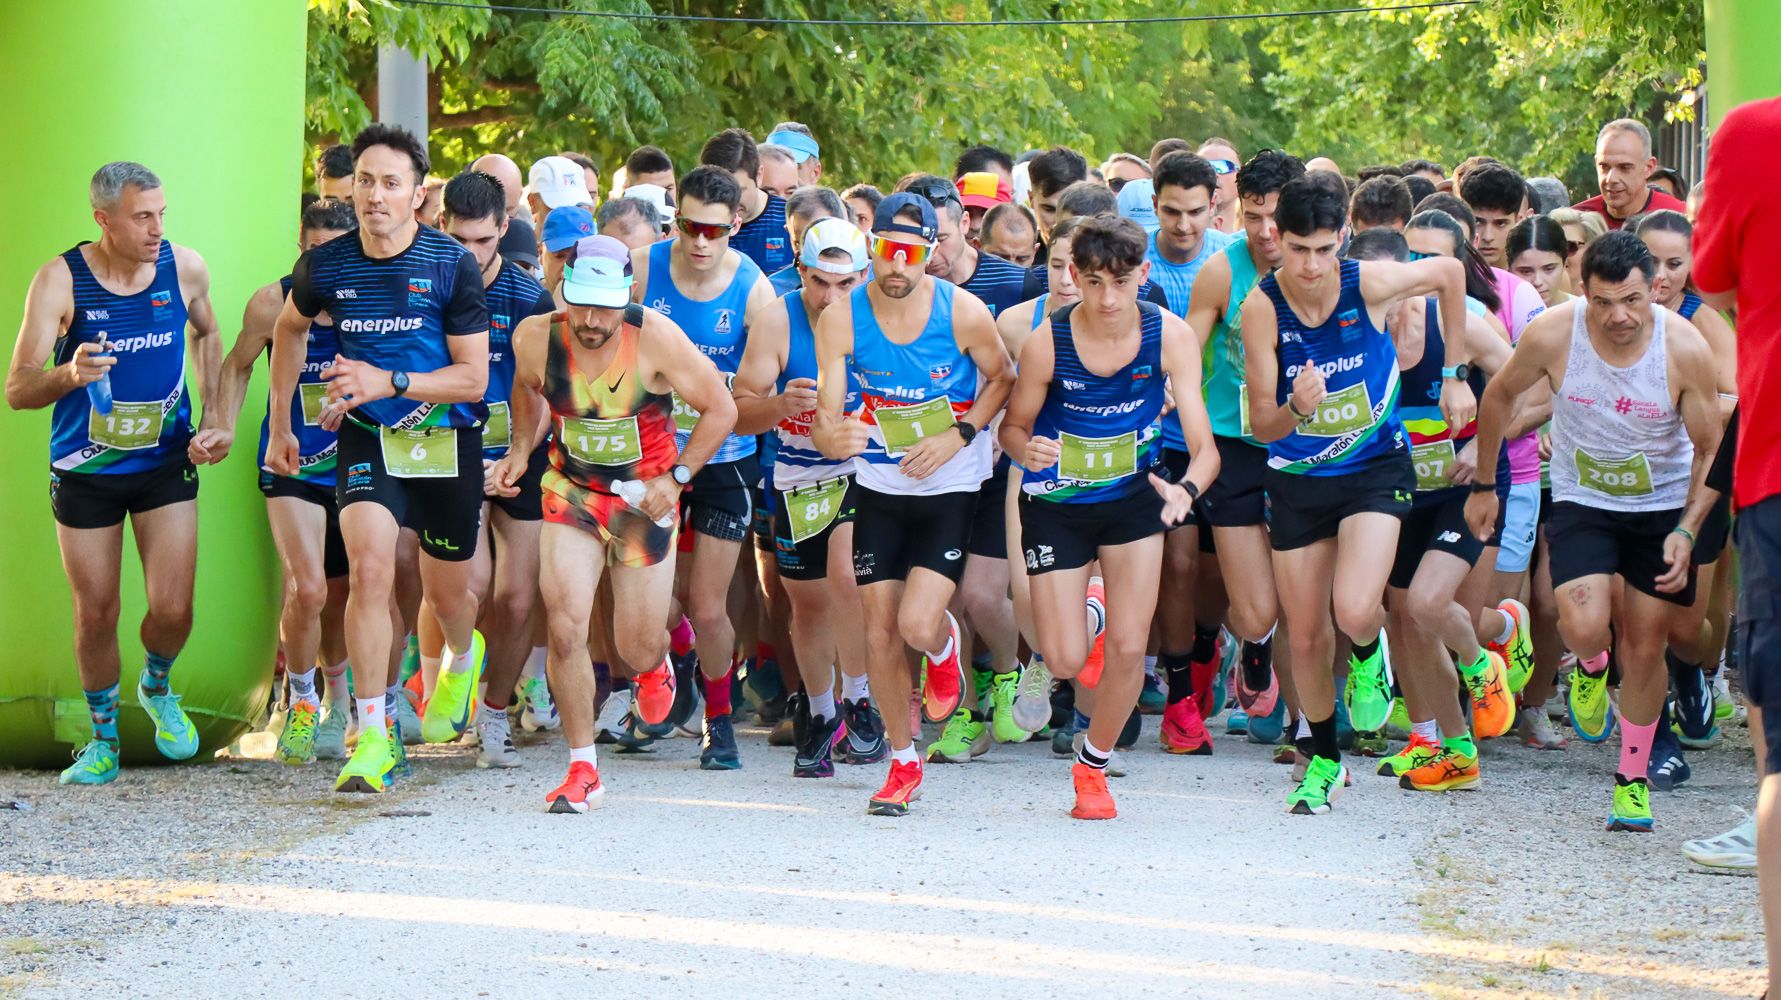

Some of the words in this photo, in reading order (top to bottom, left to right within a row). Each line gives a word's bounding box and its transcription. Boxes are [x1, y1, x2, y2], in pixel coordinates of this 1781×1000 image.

[340, 316, 423, 334] enerplus
[105, 416, 152, 436] 132
[911, 421, 925, 438] 1
[410, 442, 427, 461] 6
[577, 435, 627, 452] 175
[1084, 452, 1114, 469] 11
[1587, 467, 1639, 487] 208
[804, 497, 832, 522] 84
